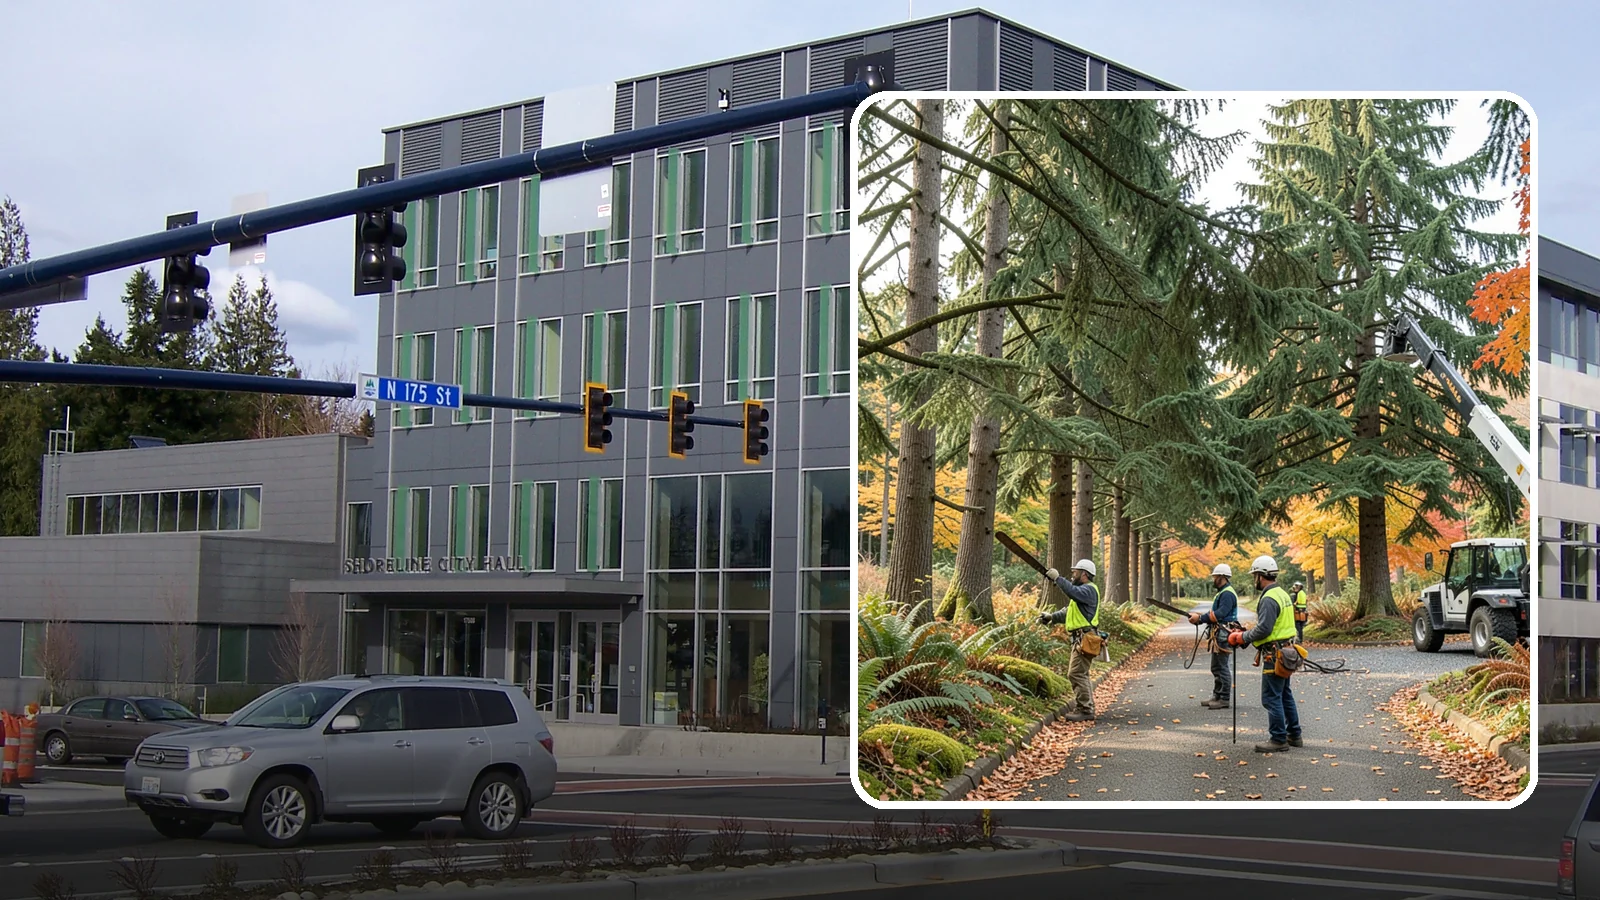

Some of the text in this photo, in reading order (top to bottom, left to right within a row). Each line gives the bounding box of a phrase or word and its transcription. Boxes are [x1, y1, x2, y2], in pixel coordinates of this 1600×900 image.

[387, 380, 451, 406] N 175 St
[344, 555, 525, 574] SHORELINE CITY HALL
